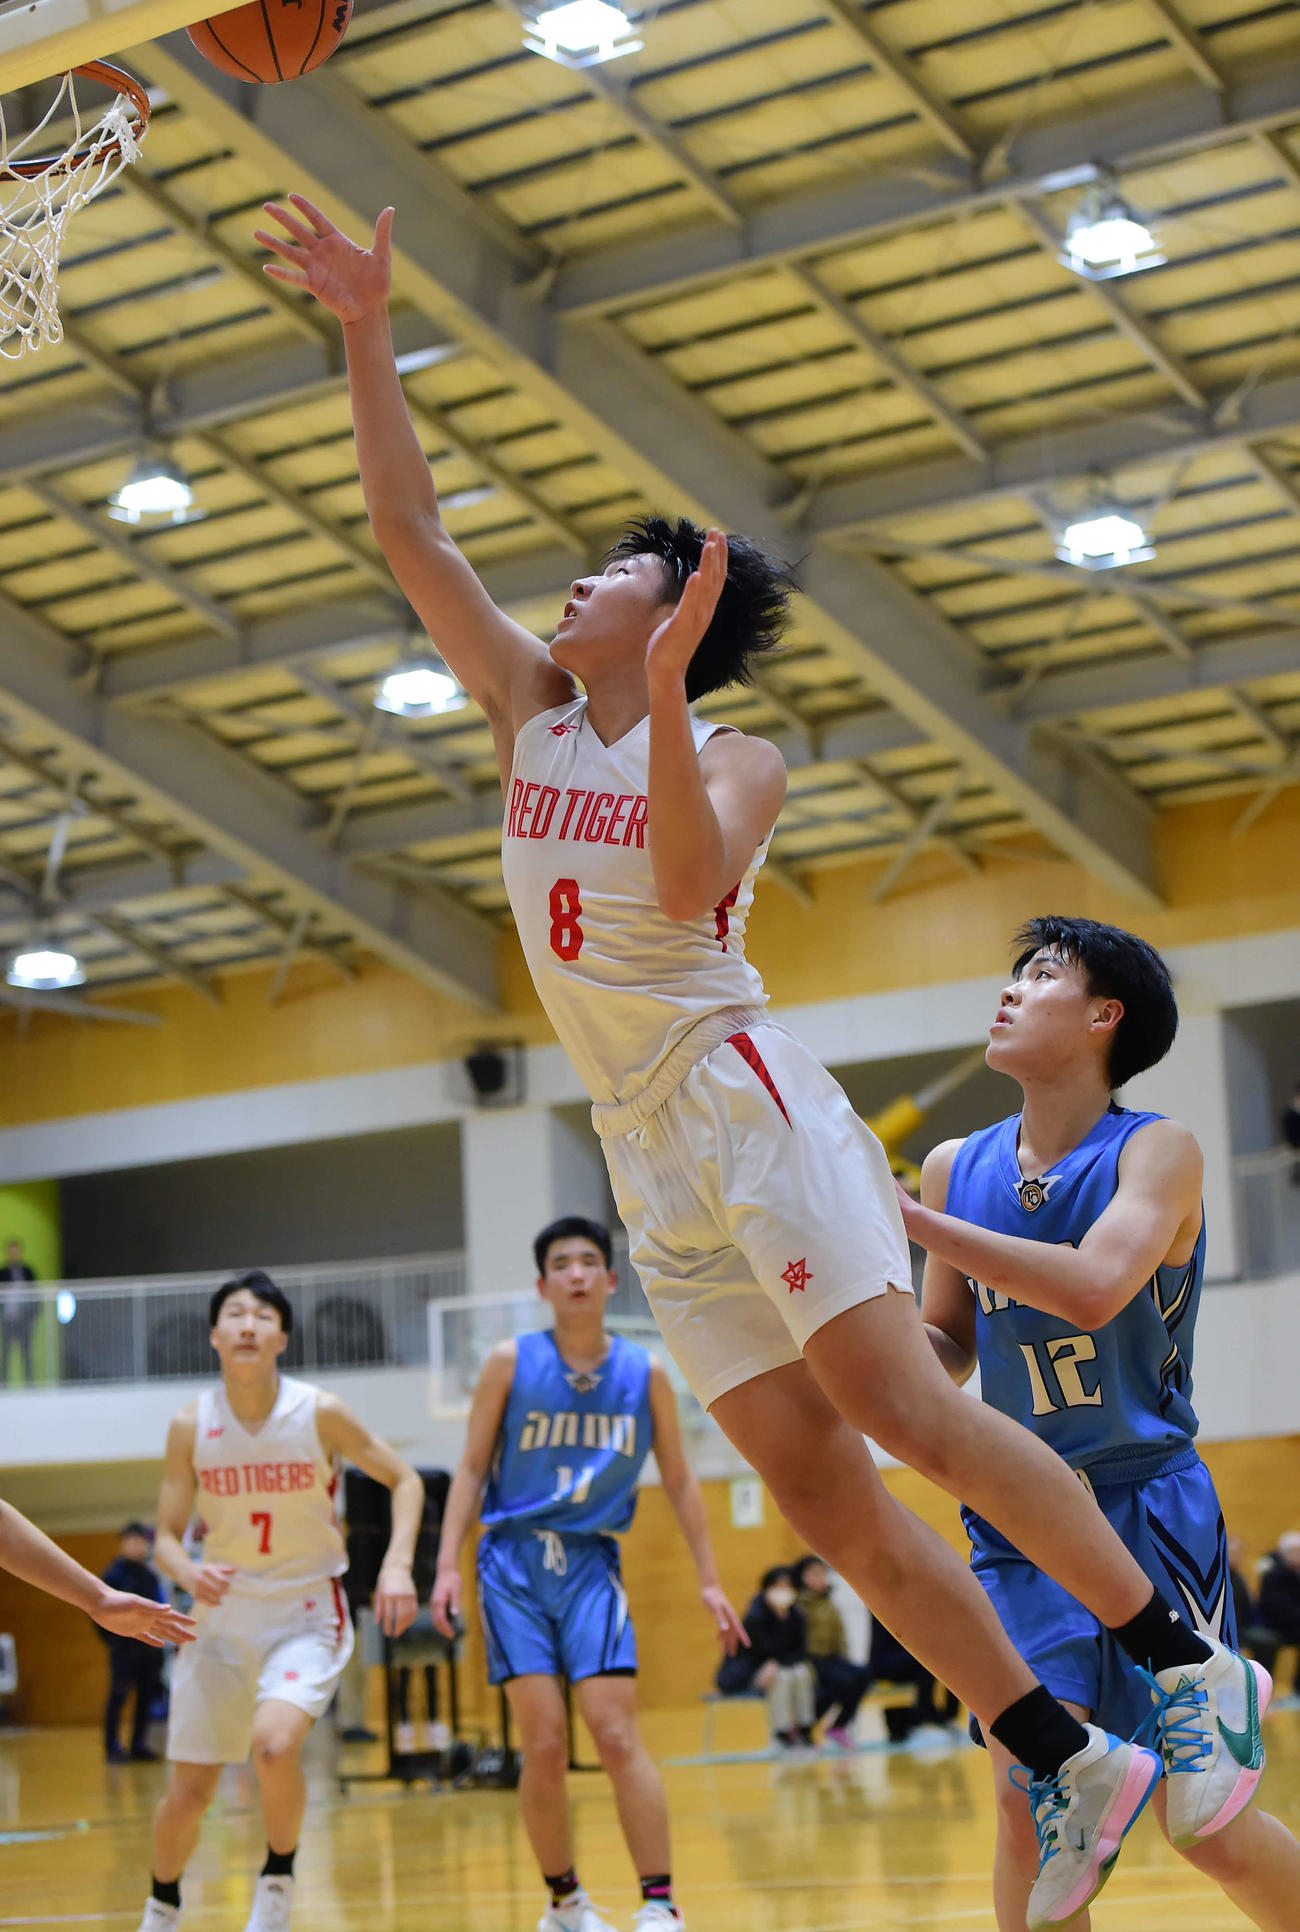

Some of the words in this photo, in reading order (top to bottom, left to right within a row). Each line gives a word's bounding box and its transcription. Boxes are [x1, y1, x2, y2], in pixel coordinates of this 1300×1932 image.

[507, 778, 560, 840] RED
[558, 787, 649, 849] TIGER
[548, 878, 584, 962] 8
[1016, 1333, 1104, 1417] 12
[201, 1466, 240, 1497] RED
[242, 1460, 316, 1494] TIGERS
[250, 1511, 272, 1554] 7
